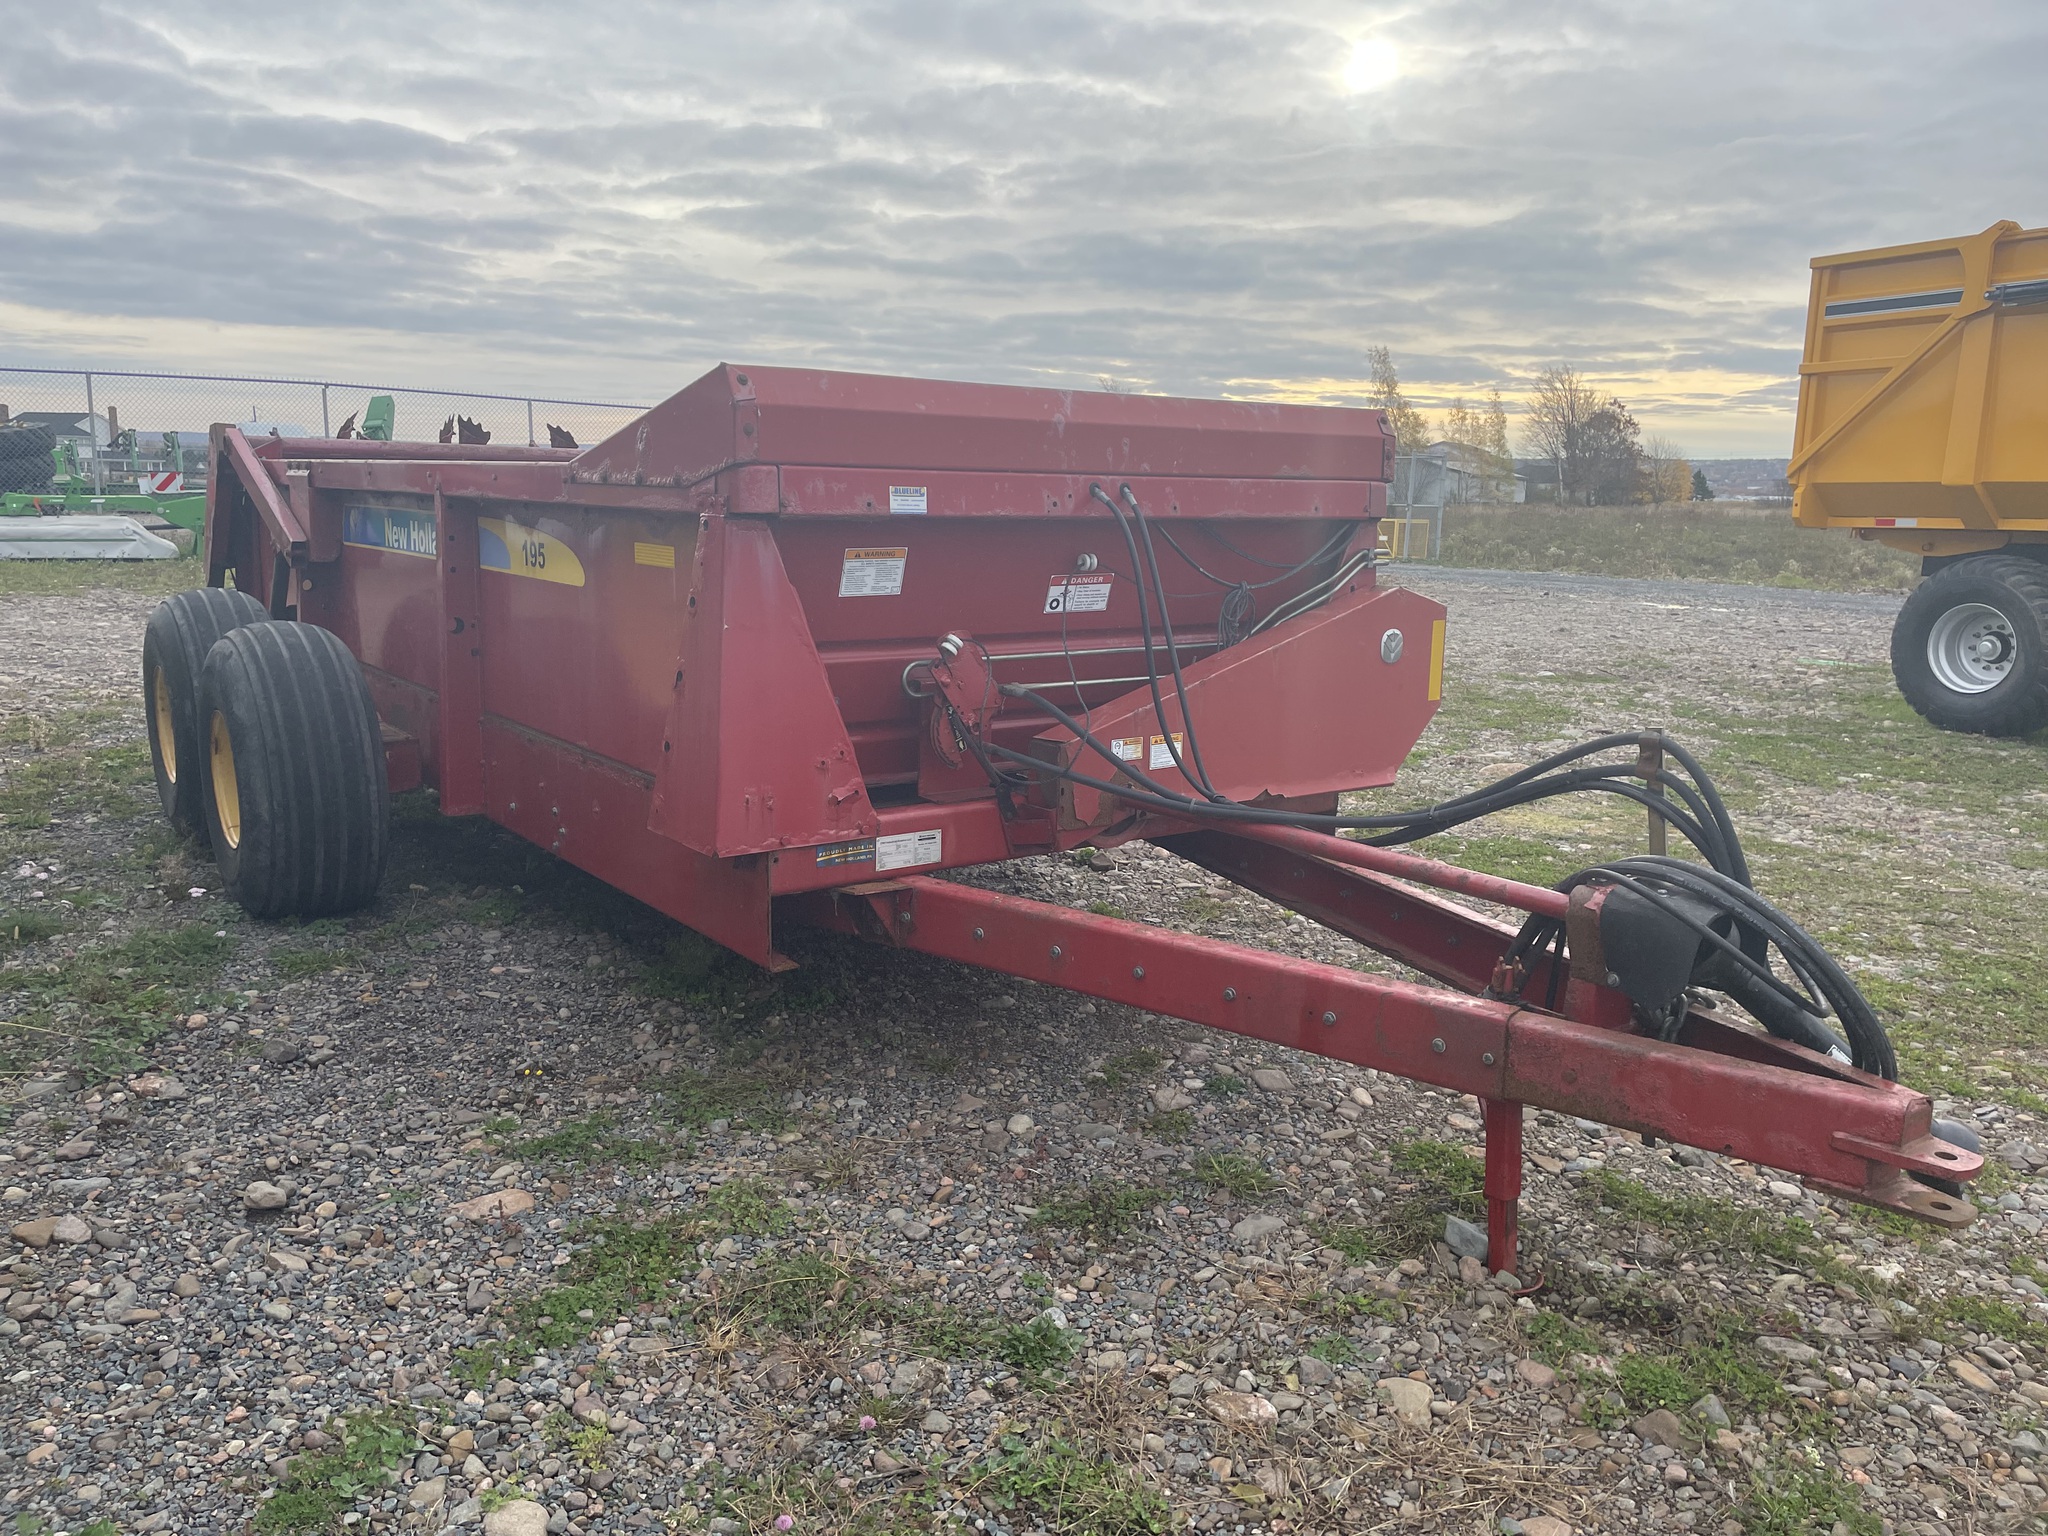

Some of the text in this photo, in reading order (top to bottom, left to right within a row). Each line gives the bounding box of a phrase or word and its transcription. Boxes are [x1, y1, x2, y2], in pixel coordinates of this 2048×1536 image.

[894, 487, 922, 495] BLUELINE
[384, 517, 408, 550] New
[522, 539, 546, 569] 195
[1070, 576, 1104, 584] DANGER
[818, 848, 846, 857] PROUDLY
